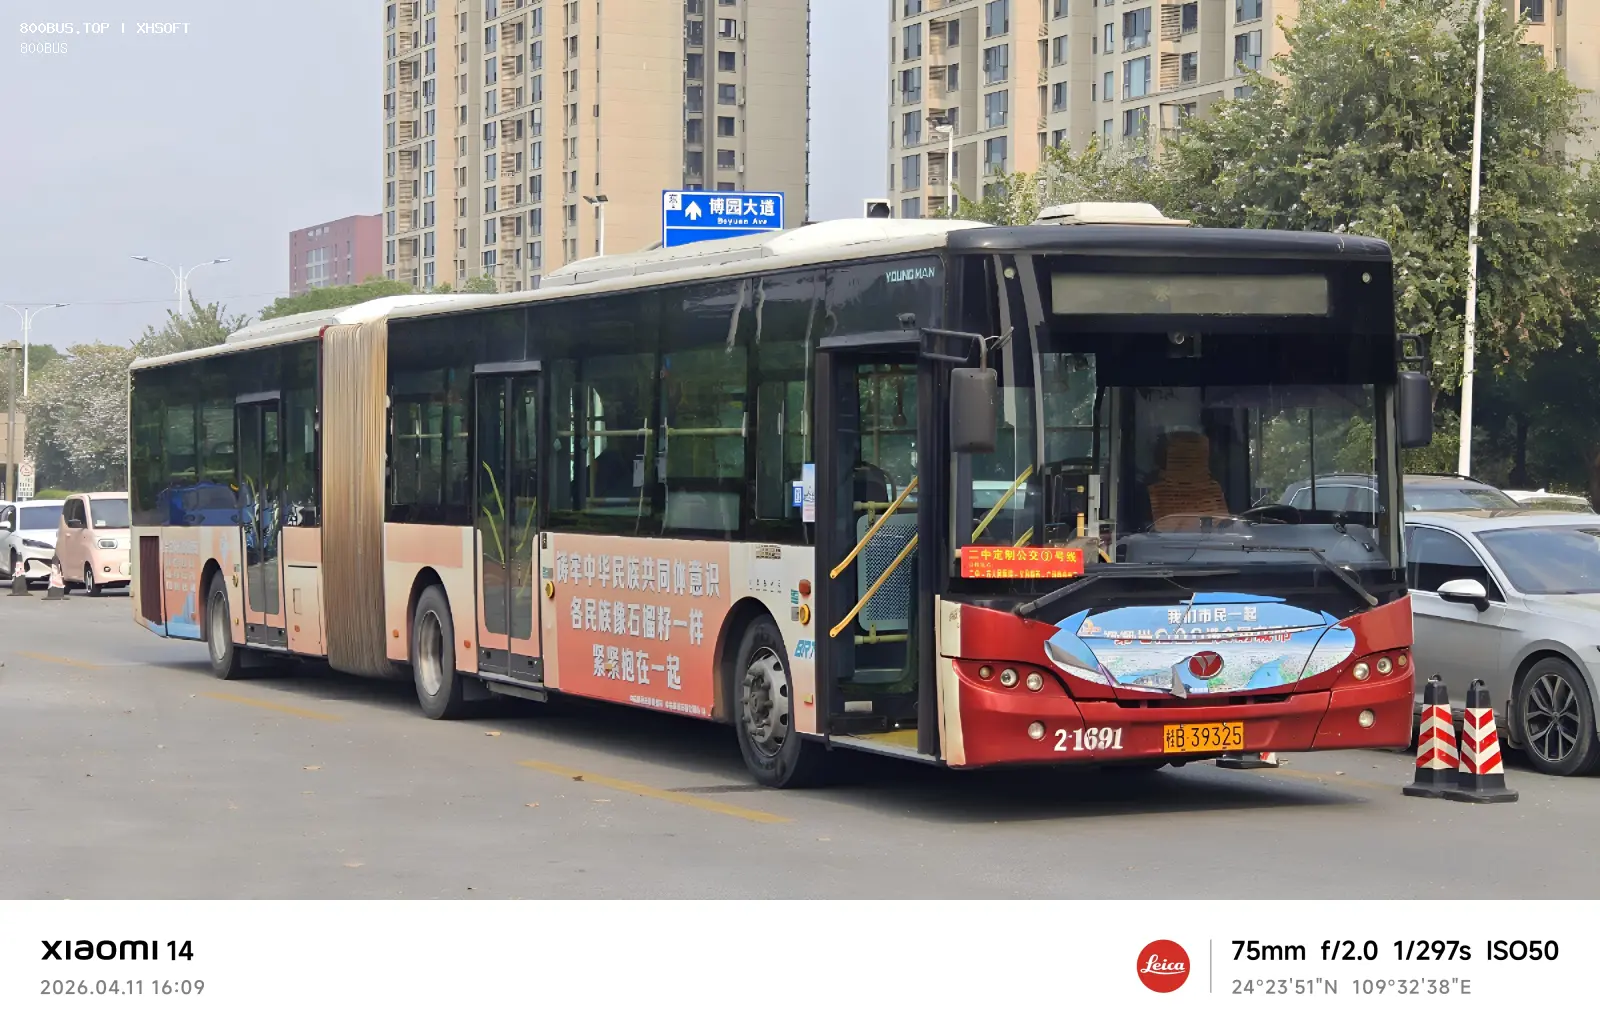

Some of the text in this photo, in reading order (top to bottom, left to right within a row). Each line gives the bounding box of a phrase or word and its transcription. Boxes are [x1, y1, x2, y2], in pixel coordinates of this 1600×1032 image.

[709, 197, 775, 216] 博园大道
[556, 550, 721, 599] 铸牢中华民族共同体意识
[570, 595, 704, 646] 各民族像石榴籽一样
[1167, 607, 1257, 625] 我们市民一起
[593, 643, 681, 690] 紧紧抱在一起
